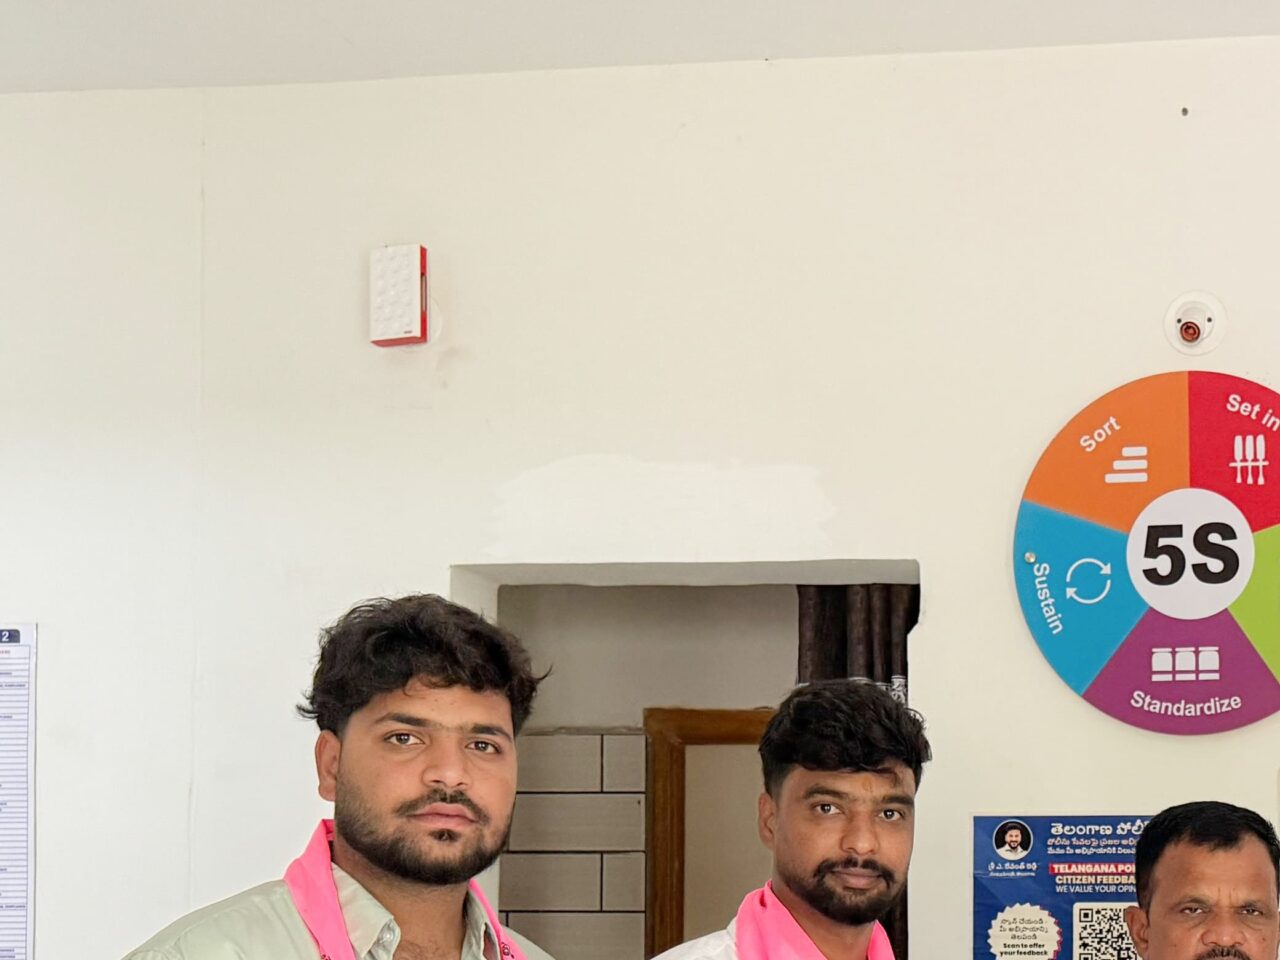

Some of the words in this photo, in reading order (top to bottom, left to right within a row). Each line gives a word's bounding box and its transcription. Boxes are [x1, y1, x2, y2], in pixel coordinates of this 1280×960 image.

[1226, 394, 1259, 422] Set
[1262, 409, 1280, 432] in
[1079, 415, 1121, 452] Sort
[1142, 522, 1240, 586] 5S
[1033, 563, 1063, 635] Sustain
[1130, 690, 1242, 717] Standardize
[1051, 822, 1113, 835] తెలంగాణ
[1116, 819, 1150, 835] పోలీ
[1052, 864, 1116, 873] TELANGANA
[1055, 875, 1096, 884] CITIZEN
[1097, 875, 1136, 884] FEEDBA
[1056, 885, 1068, 893] WE
[1069, 885, 1094, 893] VALUE
[1095, 885, 1116, 893] YOUR
[1117, 885, 1136, 893] OPIN
